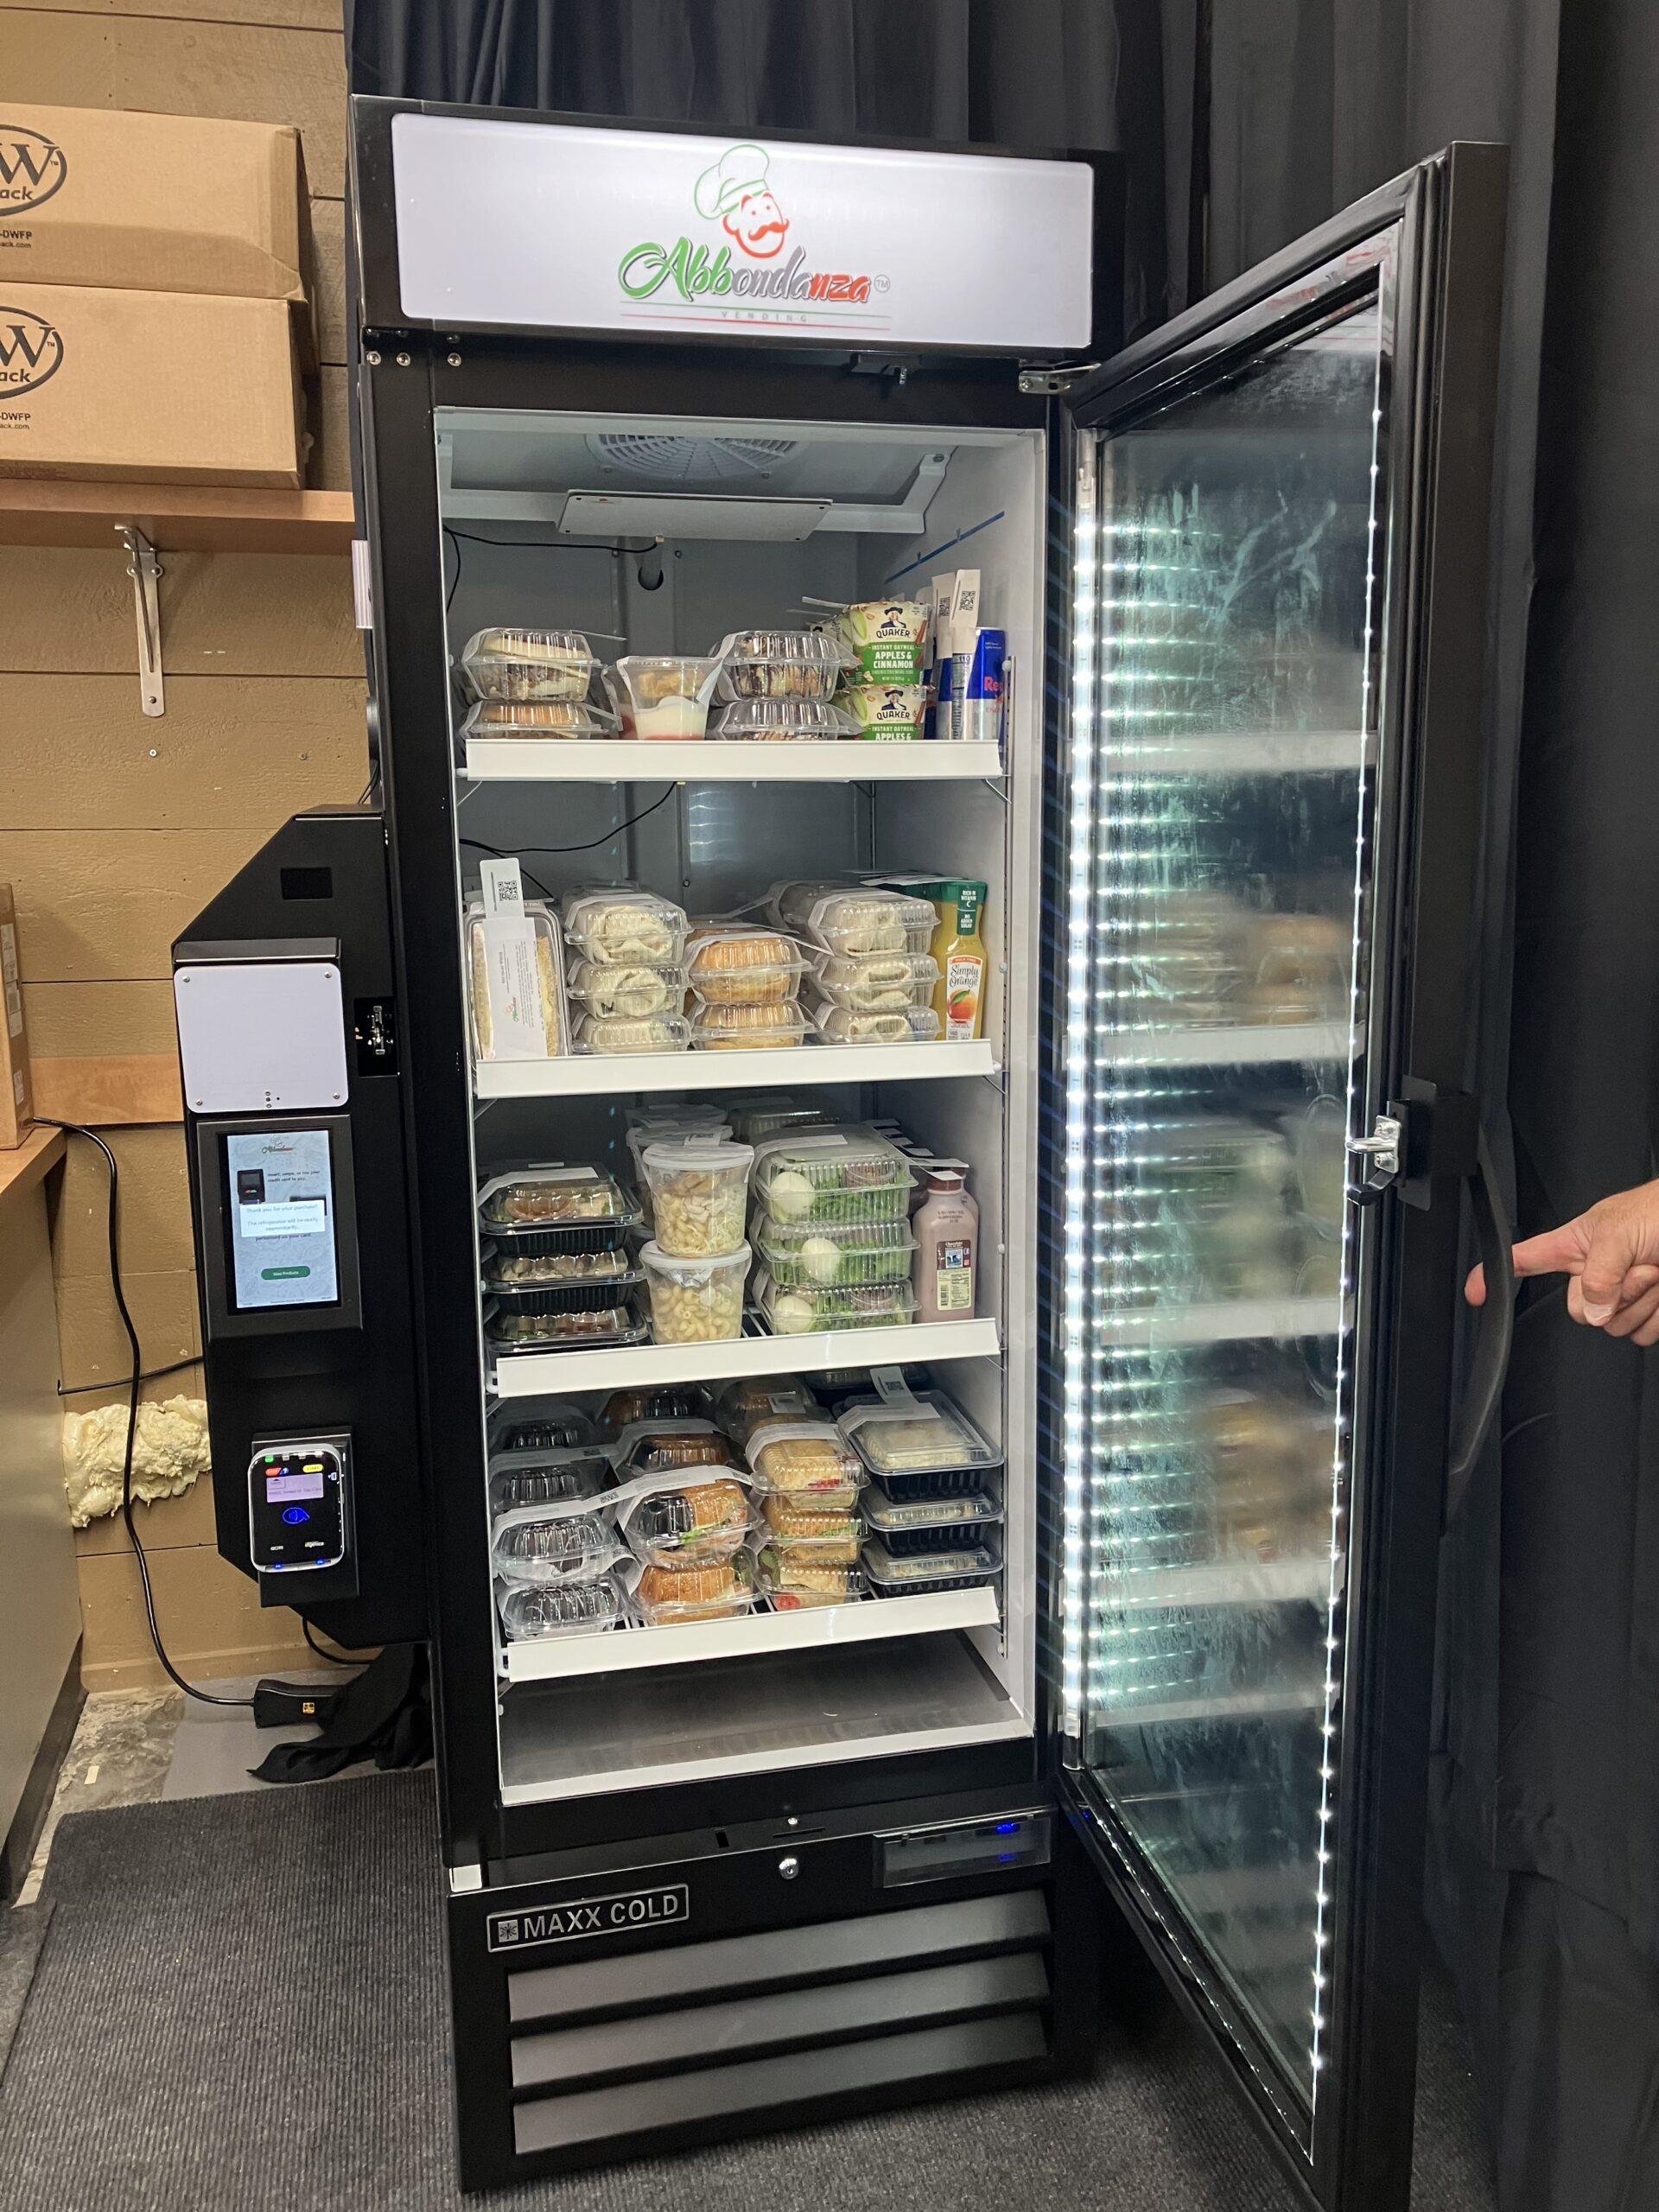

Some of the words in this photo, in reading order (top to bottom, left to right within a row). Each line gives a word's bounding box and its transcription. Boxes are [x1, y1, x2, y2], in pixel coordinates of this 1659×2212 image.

[618, 236, 871, 302] Abbondanza
[721, 310, 807, 322] VENDING
[875, 628, 911, 639] QUAKER
[874, 651, 906, 659] APPLES
[873, 660, 913, 669] CINNAMON
[876, 710, 911, 721] QUAKER
[950, 964, 979, 979] Simply
[949, 976, 978, 988] Orange
[524, 1905, 602, 1939] MAXX
[610, 1894, 678, 1924] COLD
